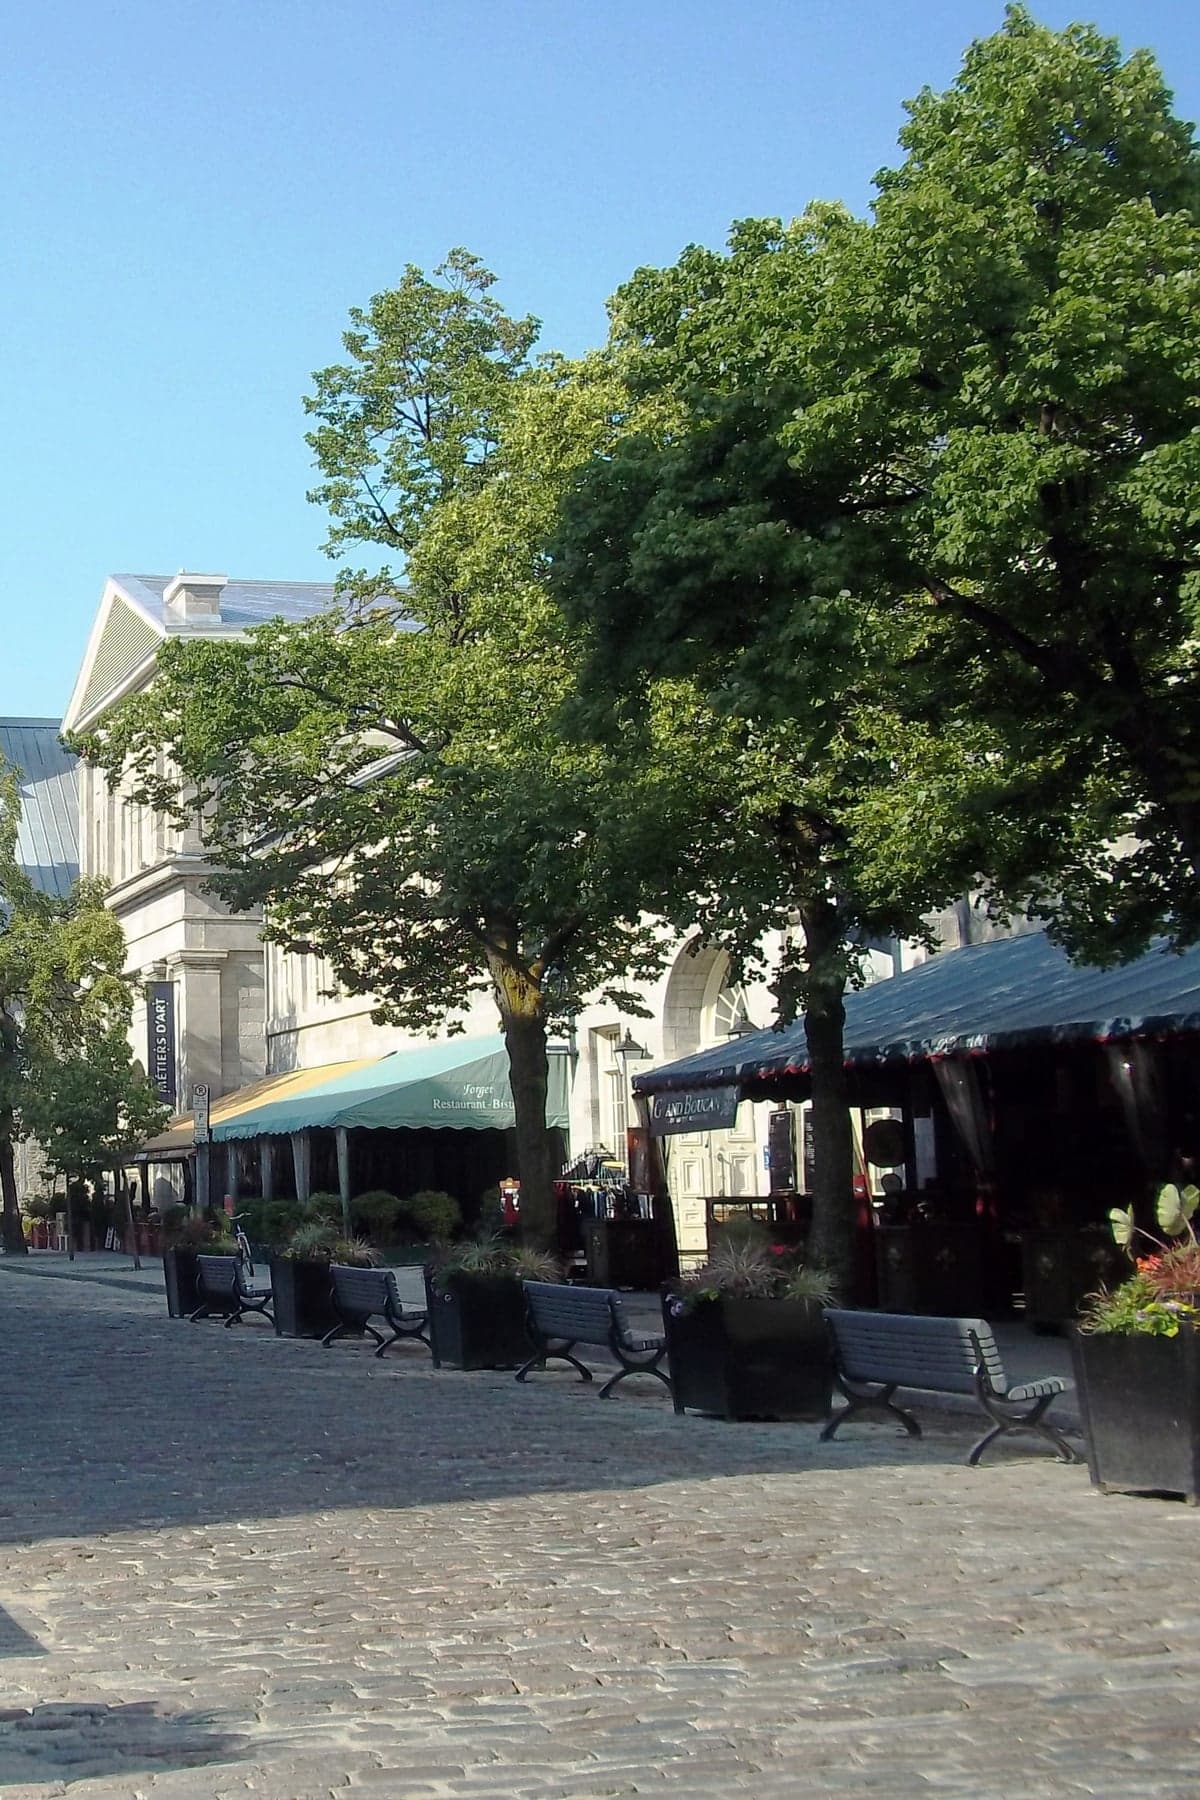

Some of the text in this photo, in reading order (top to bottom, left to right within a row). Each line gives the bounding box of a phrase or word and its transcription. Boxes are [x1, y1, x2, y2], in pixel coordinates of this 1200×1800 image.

[155, 998, 168, 1094] MÉTIERS D'ART
[654, 1099, 683, 1119] GAND
